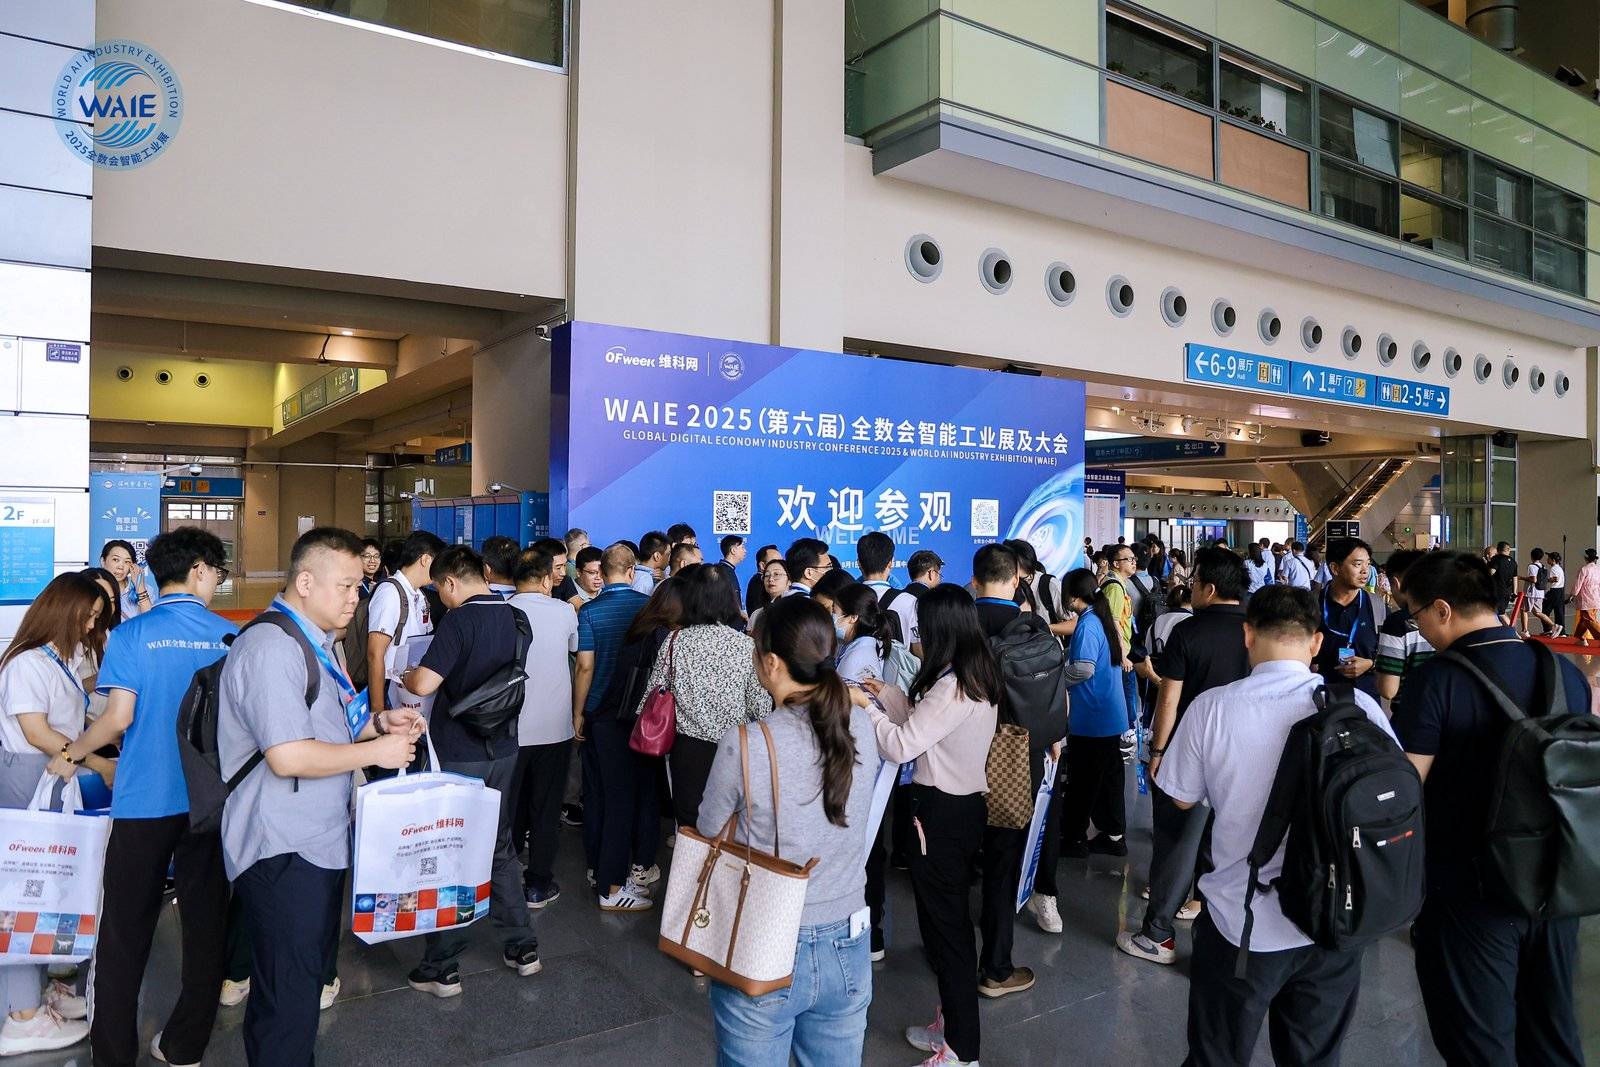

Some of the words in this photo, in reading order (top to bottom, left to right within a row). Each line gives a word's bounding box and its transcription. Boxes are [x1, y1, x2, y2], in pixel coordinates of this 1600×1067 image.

[659, 353, 699, 372] 维科网
[604, 397, 679, 427] WAIE
[623, 429, 667, 442] GLOBAL
[670, 433, 713, 445] DIGITAL
[715, 436, 766, 448] ECONOMY
[768, 438, 817, 451] INDUSTRY
[819, 441, 879, 455] CONFERENCE
[881, 446, 902, 456] 2025
[910, 448, 939, 458] WORLD
[950, 451, 989, 462] INDUSTRY
[991, 454, 1033, 464] EXHIBITION
[1034, 456, 1058, 466] (WAIE)
[777, 485, 951, 532] 欢迎参观
[436, 817, 465, 829] 维科网
